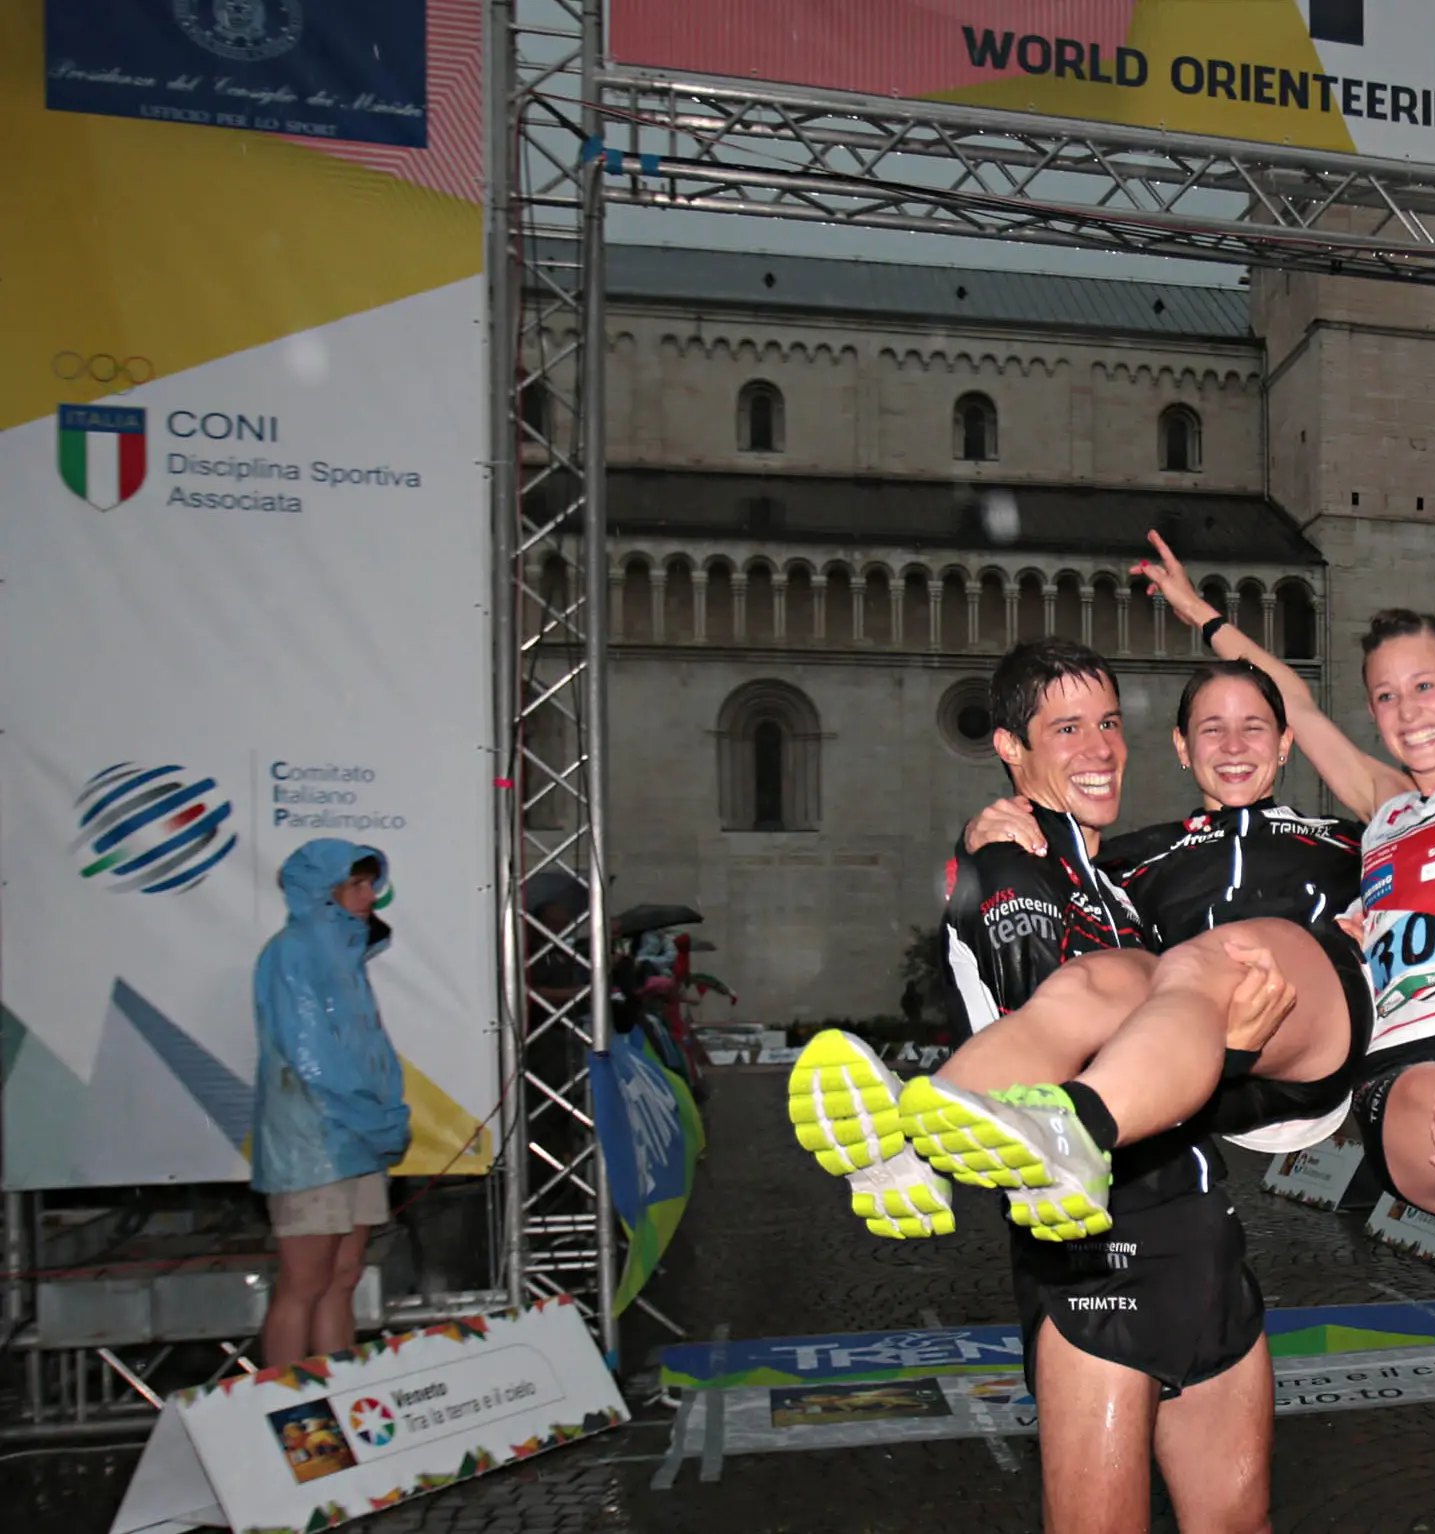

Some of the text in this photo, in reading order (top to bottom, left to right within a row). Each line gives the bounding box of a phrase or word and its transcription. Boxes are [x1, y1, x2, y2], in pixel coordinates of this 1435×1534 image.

[962, 26, 1148, 87] WORLD
[216, 112, 248, 126] PER
[253, 116, 280, 130] LO
[285, 120, 337, 136] SPORT
[65, 409, 141, 428] ITALIA
[167, 410, 278, 442] CONI
[168, 453, 421, 488] Disciplina Sportiva
[167, 486, 301, 513] Associata
[271, 761, 375, 784] Comitato
[273, 784, 357, 804] Italiano
[273, 808, 406, 831] Paralimpico
[989, 912, 1057, 949] team
[1068, 1297, 1138, 1311] TRIMTEX
[1277, 1376, 1331, 1388] rra
[1346, 1371, 1368, 1382] e
[1381, 1366, 1399, 1378] il
[390, 1382, 448, 1408] Veneto
[402, 1412, 430, 1433] Tra
[482, 1394, 493, 1409] e
[504, 1378, 536, 1402] cielo
